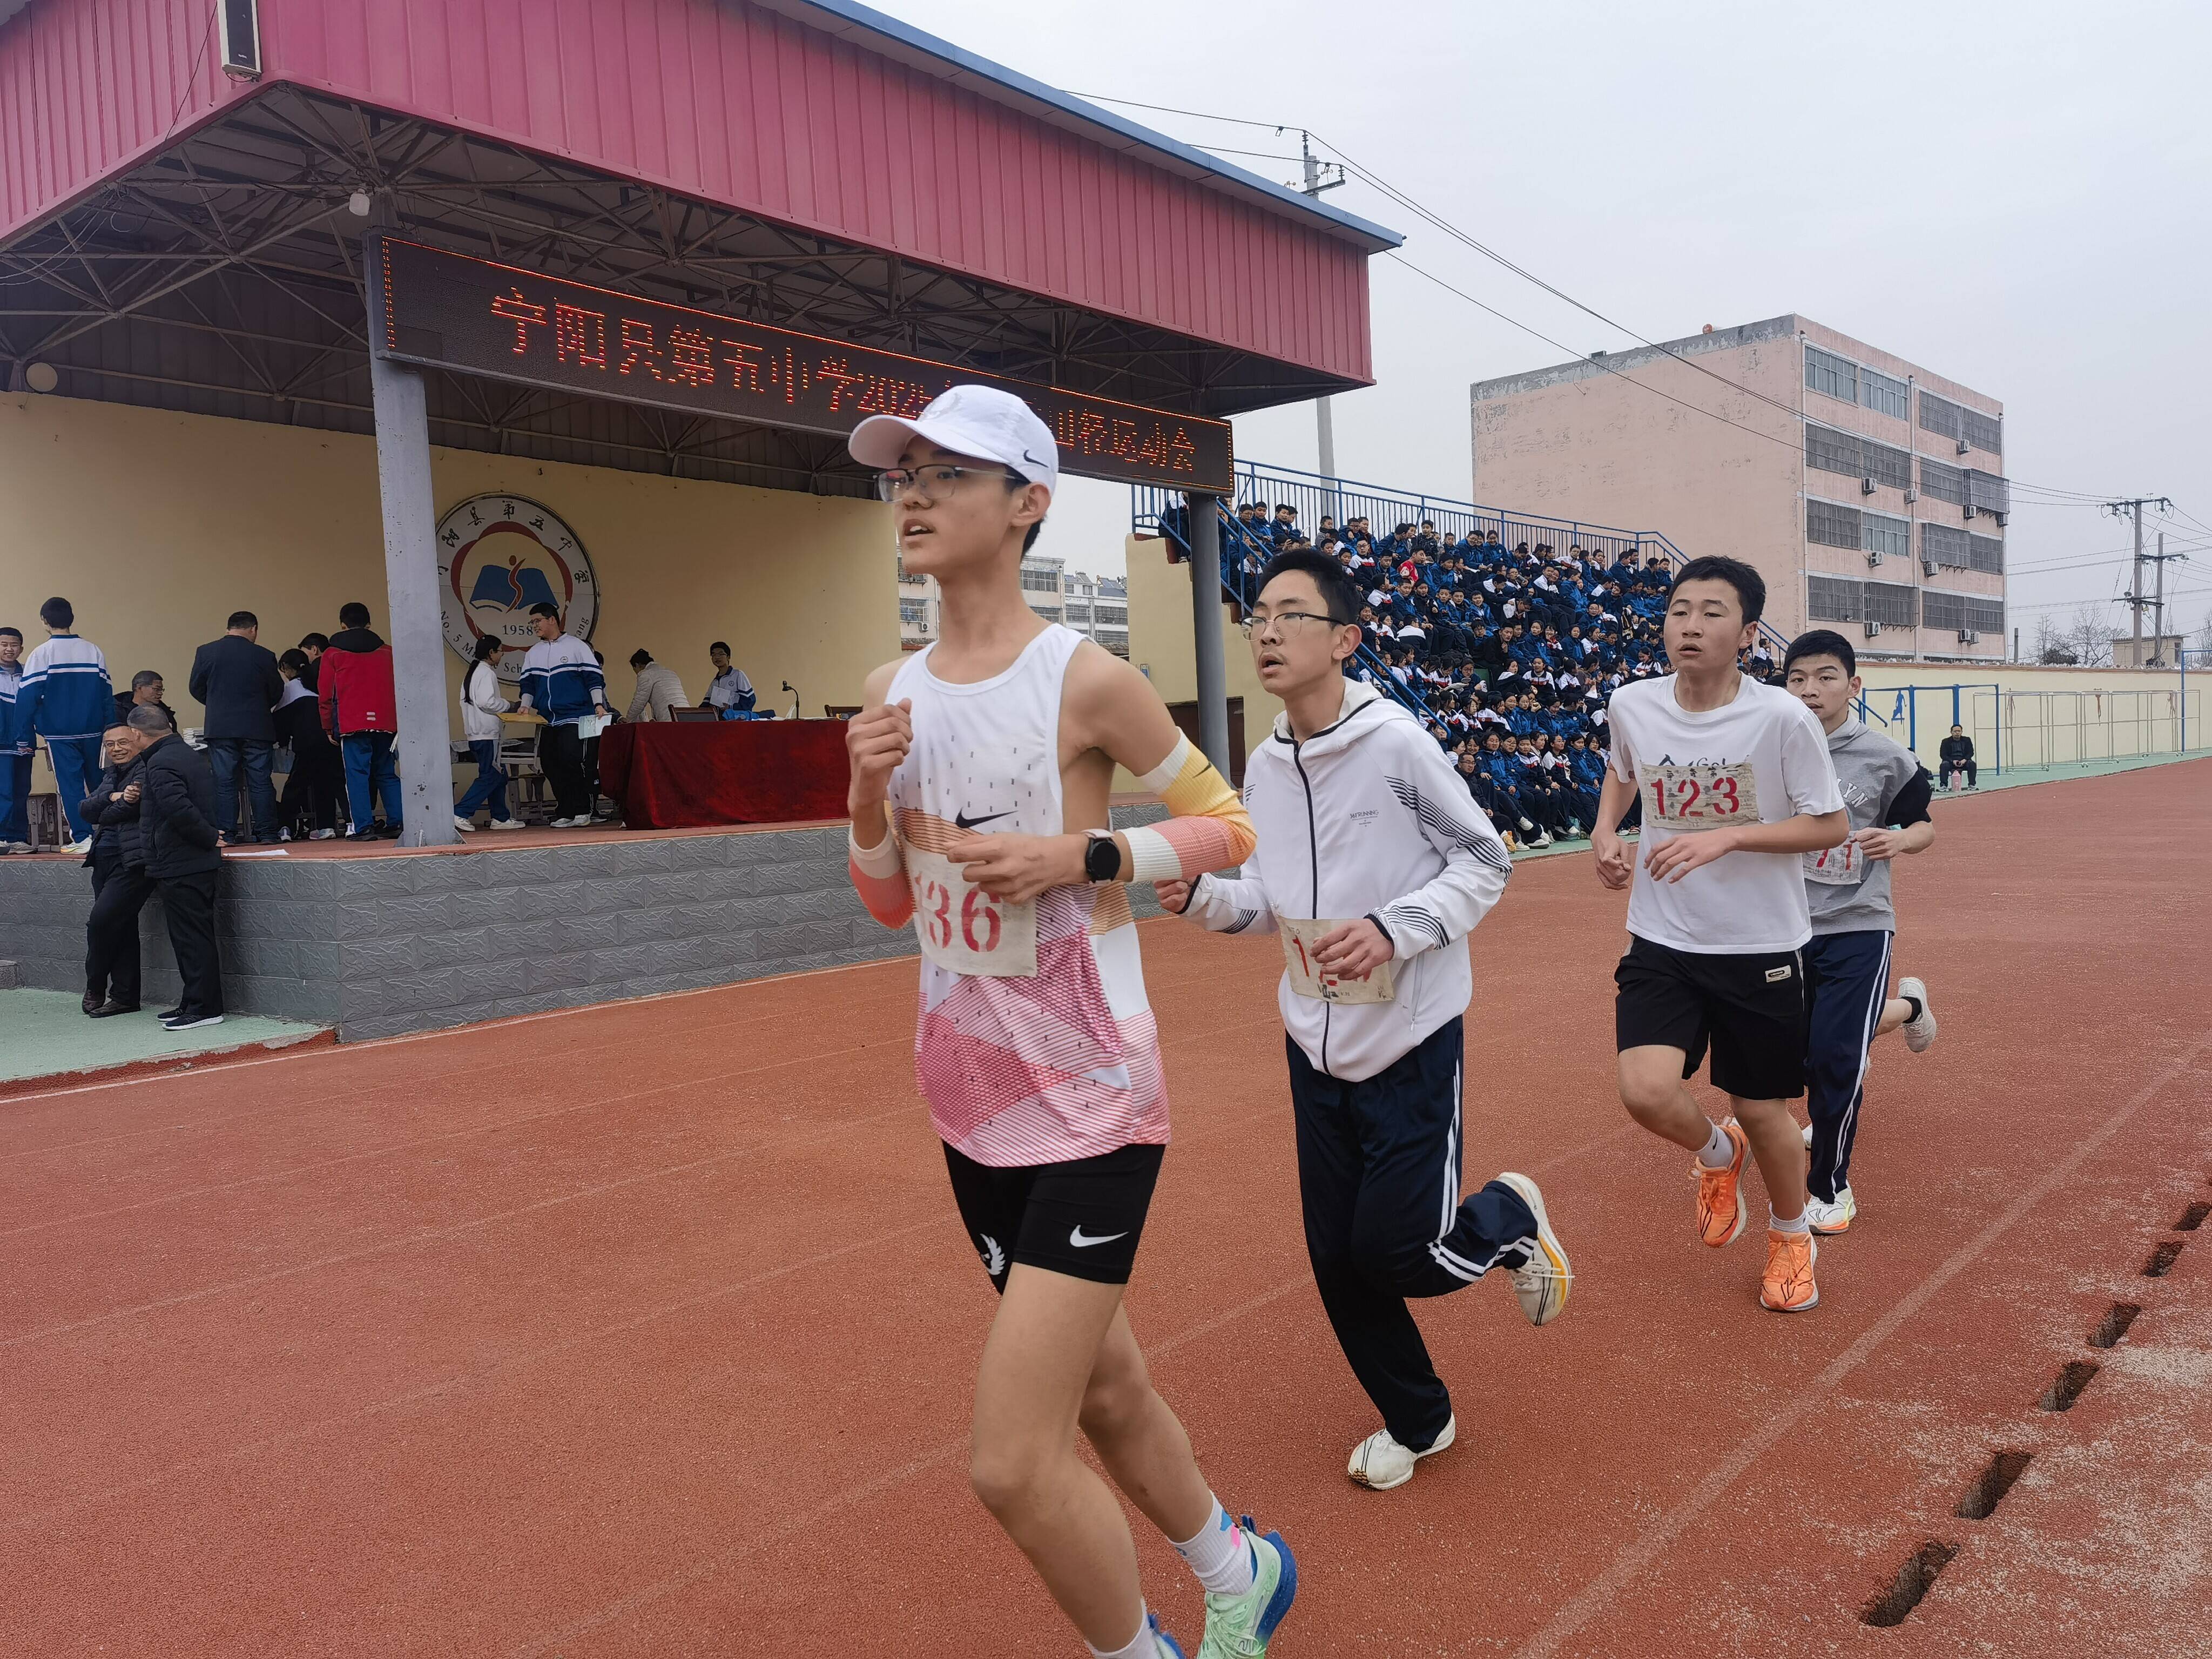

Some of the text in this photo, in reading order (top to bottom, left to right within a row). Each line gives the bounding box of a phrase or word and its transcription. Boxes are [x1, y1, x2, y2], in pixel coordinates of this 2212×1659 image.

[502, 624, 534, 636] 1958
[453, 634, 462, 643] 5
[1651, 777, 1740, 817] 123
